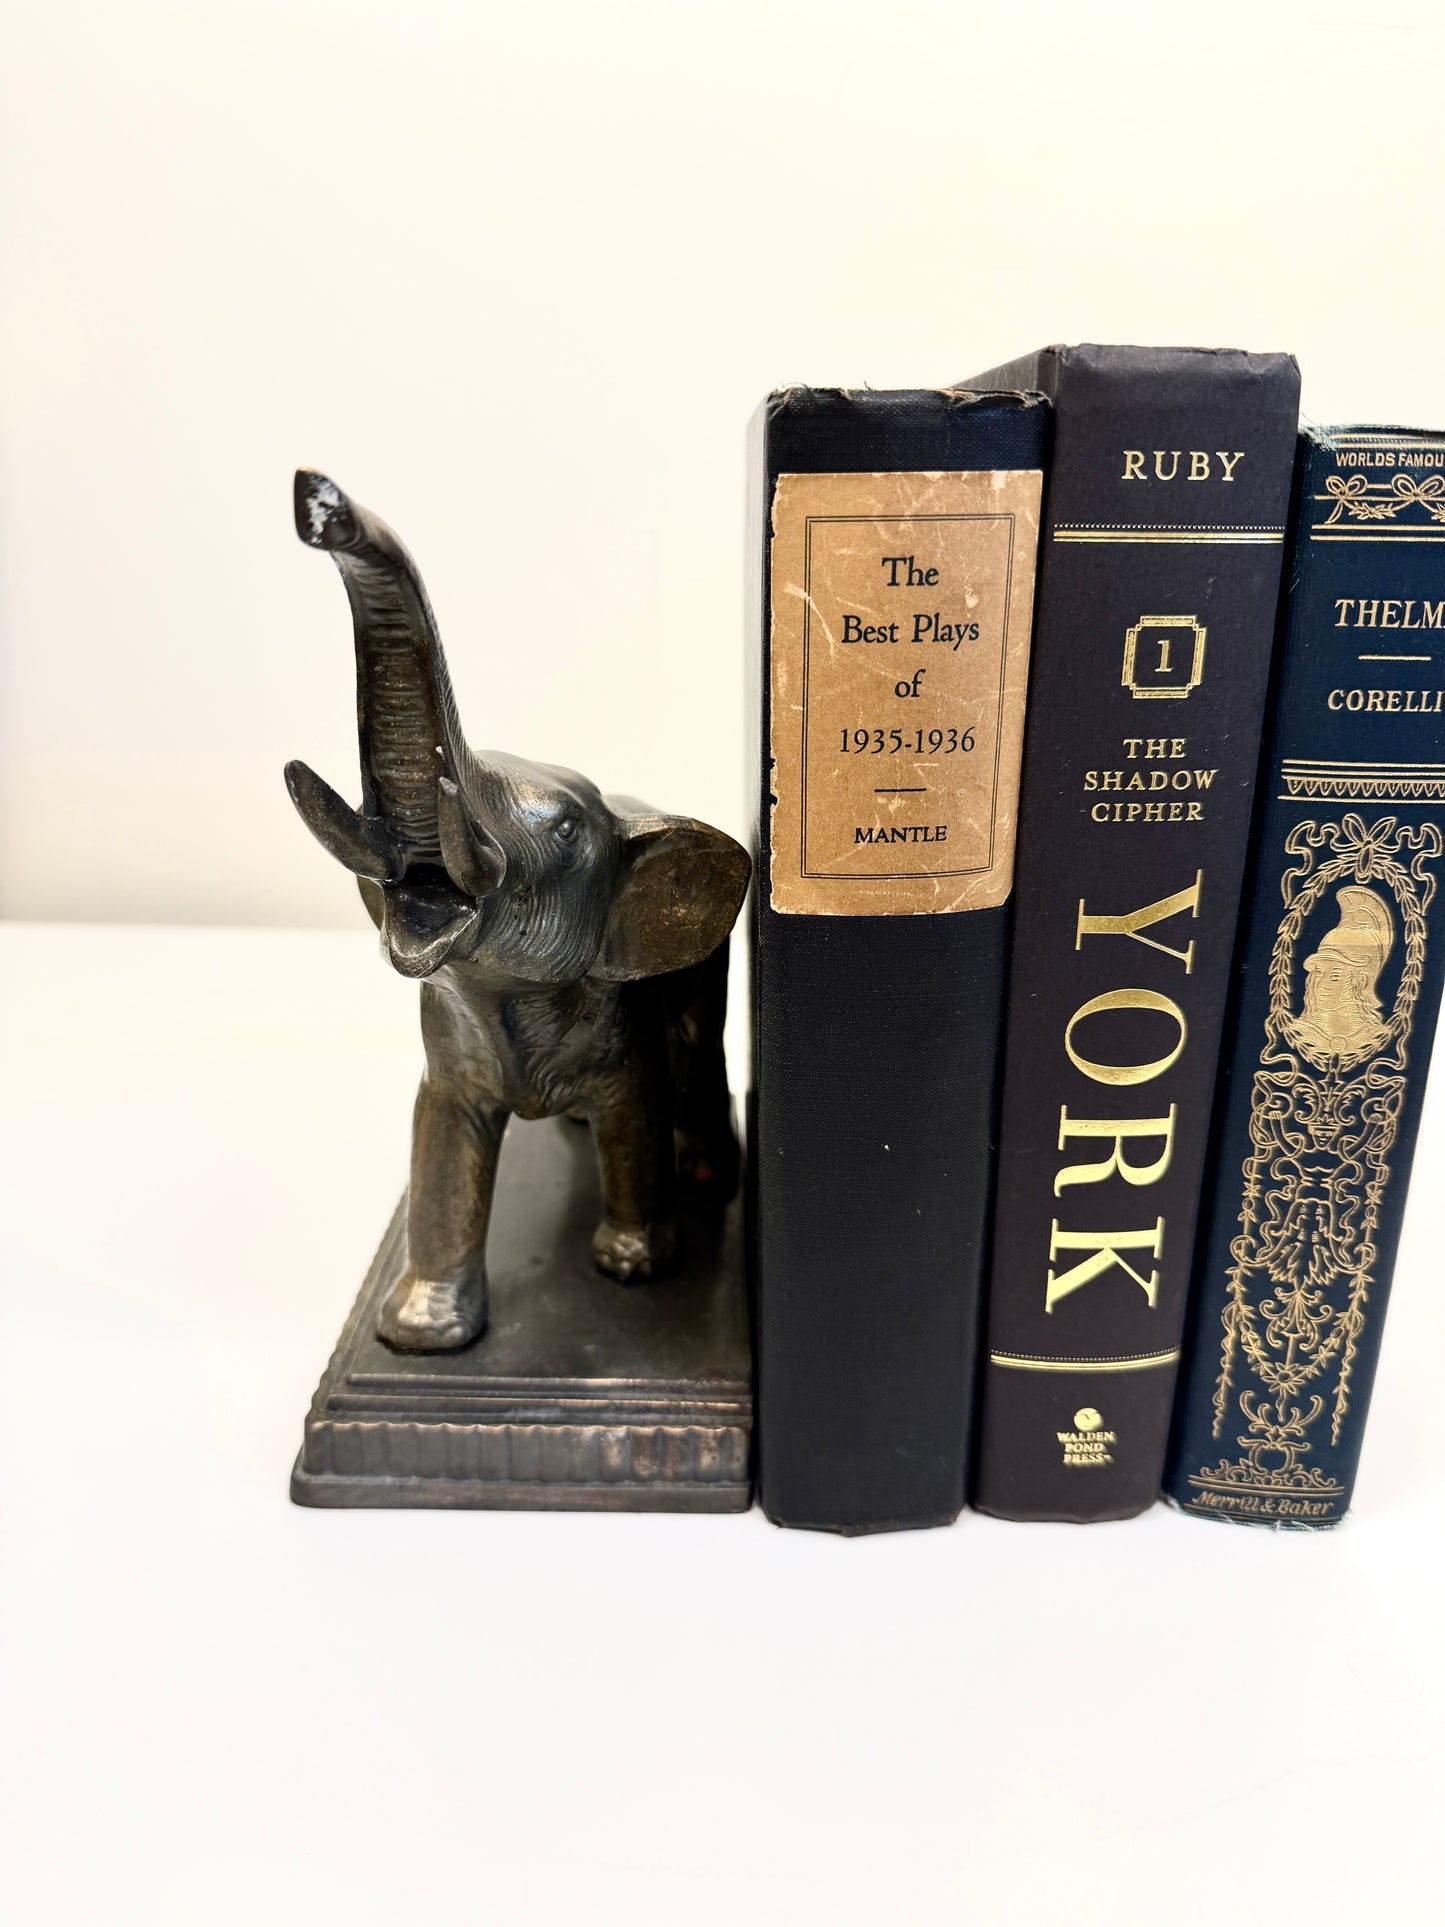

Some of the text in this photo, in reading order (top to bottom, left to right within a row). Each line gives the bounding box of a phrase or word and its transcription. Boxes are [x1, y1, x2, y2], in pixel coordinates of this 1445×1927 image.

[1121, 450, 1245, 482] RUBY
[1335, 452, 1396, 467] WORLDS
[882, 556, 939, 587] The
[1334, 599, 1445, 629] THELM
[841, 614, 980, 651] Best Plays
[1154, 639, 1173, 673] 1
[894, 669, 926, 698] of
[1327, 689, 1445, 713] CORELLI
[839, 726, 976, 755] 1935-1936
[1122, 738, 1187, 759] THE
[1084, 769, 1217, 791] SHADOW
[1091, 802, 1204, 822] CIPHER
[854, 825, 948, 844] MANTLE
[1045, 868, 1203, 1314] YORK
[1056, 1431, 1116, 1443] WALDEN
[1064, 1442, 1106, 1454] POND
[1192, 1490, 1334, 1515] Merrill & Baker
